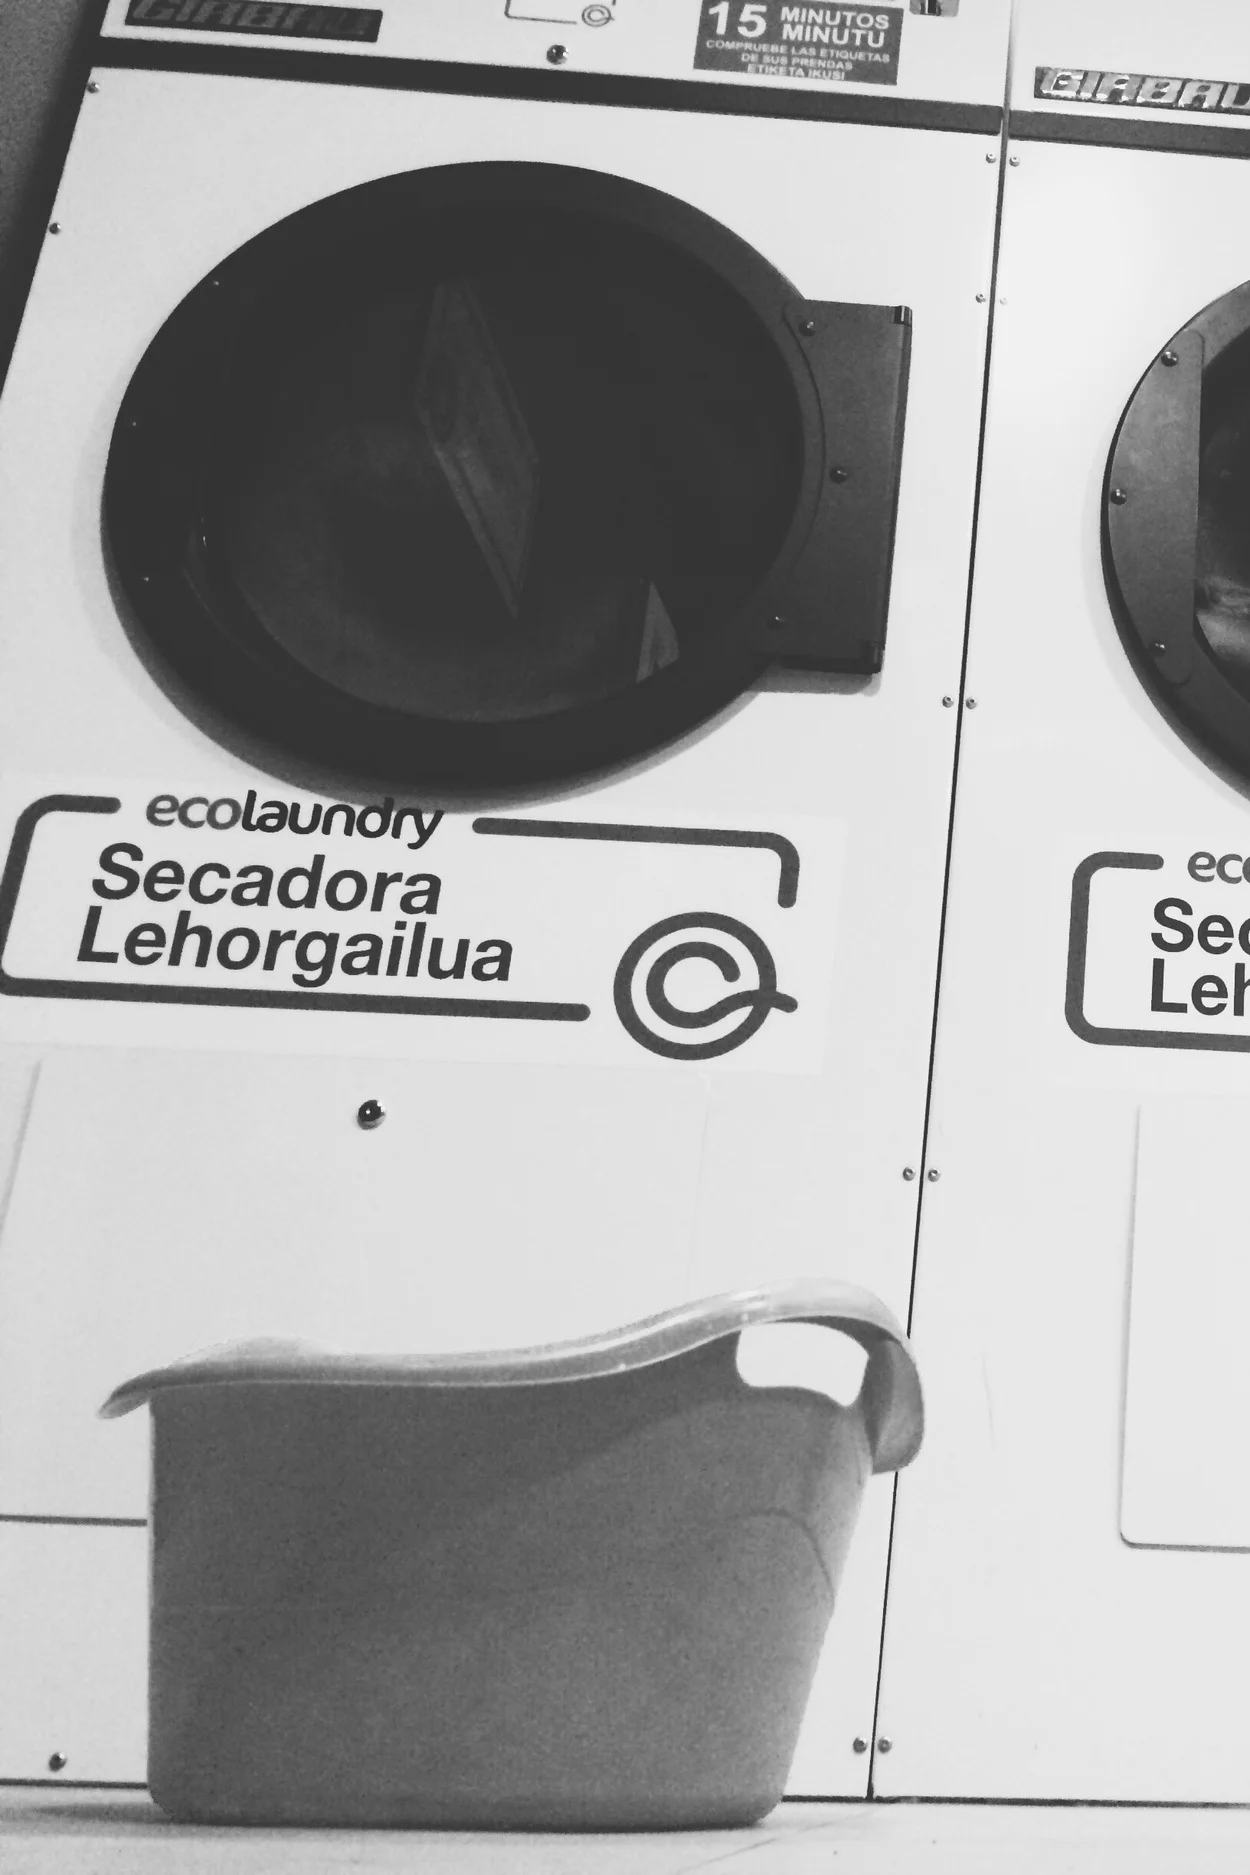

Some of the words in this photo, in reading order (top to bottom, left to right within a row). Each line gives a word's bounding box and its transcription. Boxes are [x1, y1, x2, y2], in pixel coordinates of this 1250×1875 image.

[708, 1, 768, 38] 15
[780, 6, 890, 30] MINUTOS
[782, 23, 885, 48] MINUTU
[705, 39, 788, 54] COMPRUEBE
[791, 46, 816, 57] LAS
[819, 48, 890, 63] ETIQUETAS
[741, 53, 758, 63] DE
[762, 54, 788, 66] SUS
[791, 57, 853, 70] PRENDAS
[747, 63, 805, 78] ETIKETA
[808, 68, 846, 81] IKUSI
[145, 789, 445, 851] ecolaundry
[92, 842, 442, 916] Secadora
[76, 904, 514, 989] Lehorgailua
